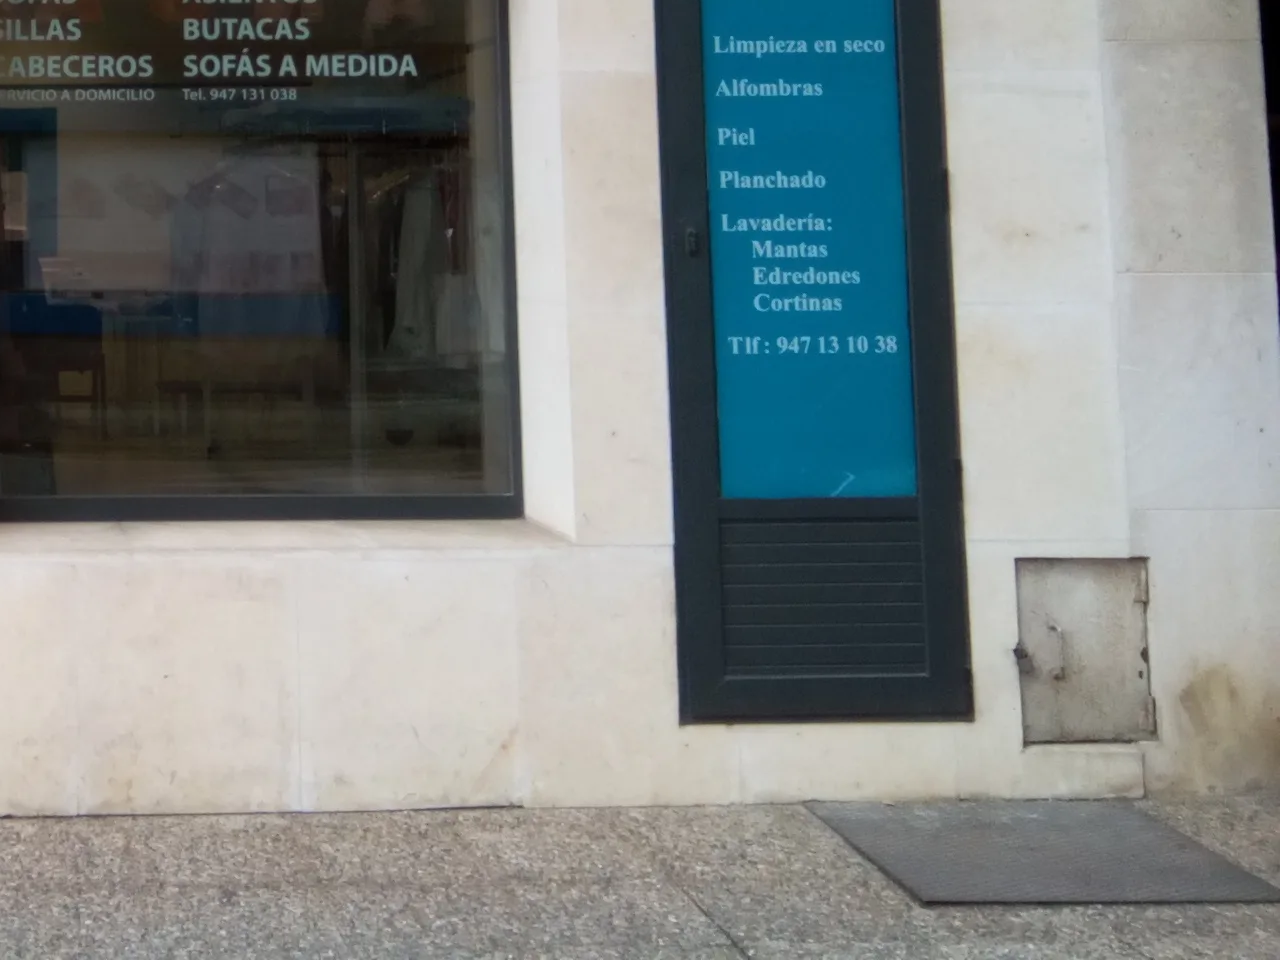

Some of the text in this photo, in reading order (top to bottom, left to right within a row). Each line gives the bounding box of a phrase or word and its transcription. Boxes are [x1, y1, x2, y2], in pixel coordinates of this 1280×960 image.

[182, 18, 311, 41] BUTACAS
[713, 36, 886, 58] Limpieza en seco
[182, 48, 418, 77] SOFÁS A MEDIDA
[60, 90, 71, 101] A
[75, 88, 155, 101] DOMICILIO
[182, 88, 298, 101] Tel. 947 131 038
[716, 79, 823, 97] Alfombras
[718, 128, 756, 146] Piel
[719, 171, 826, 189] Planchado
[721, 214, 833, 232] Lavadería:
[752, 240, 828, 258] Mantas
[753, 267, 861, 285] Edredones
[753, 293, 843, 312] Cortinas
[776, 336, 811, 355] 947
[818, 336, 839, 354] 13
[847, 336, 869, 354] 10
[874, 335, 898, 354] 38
